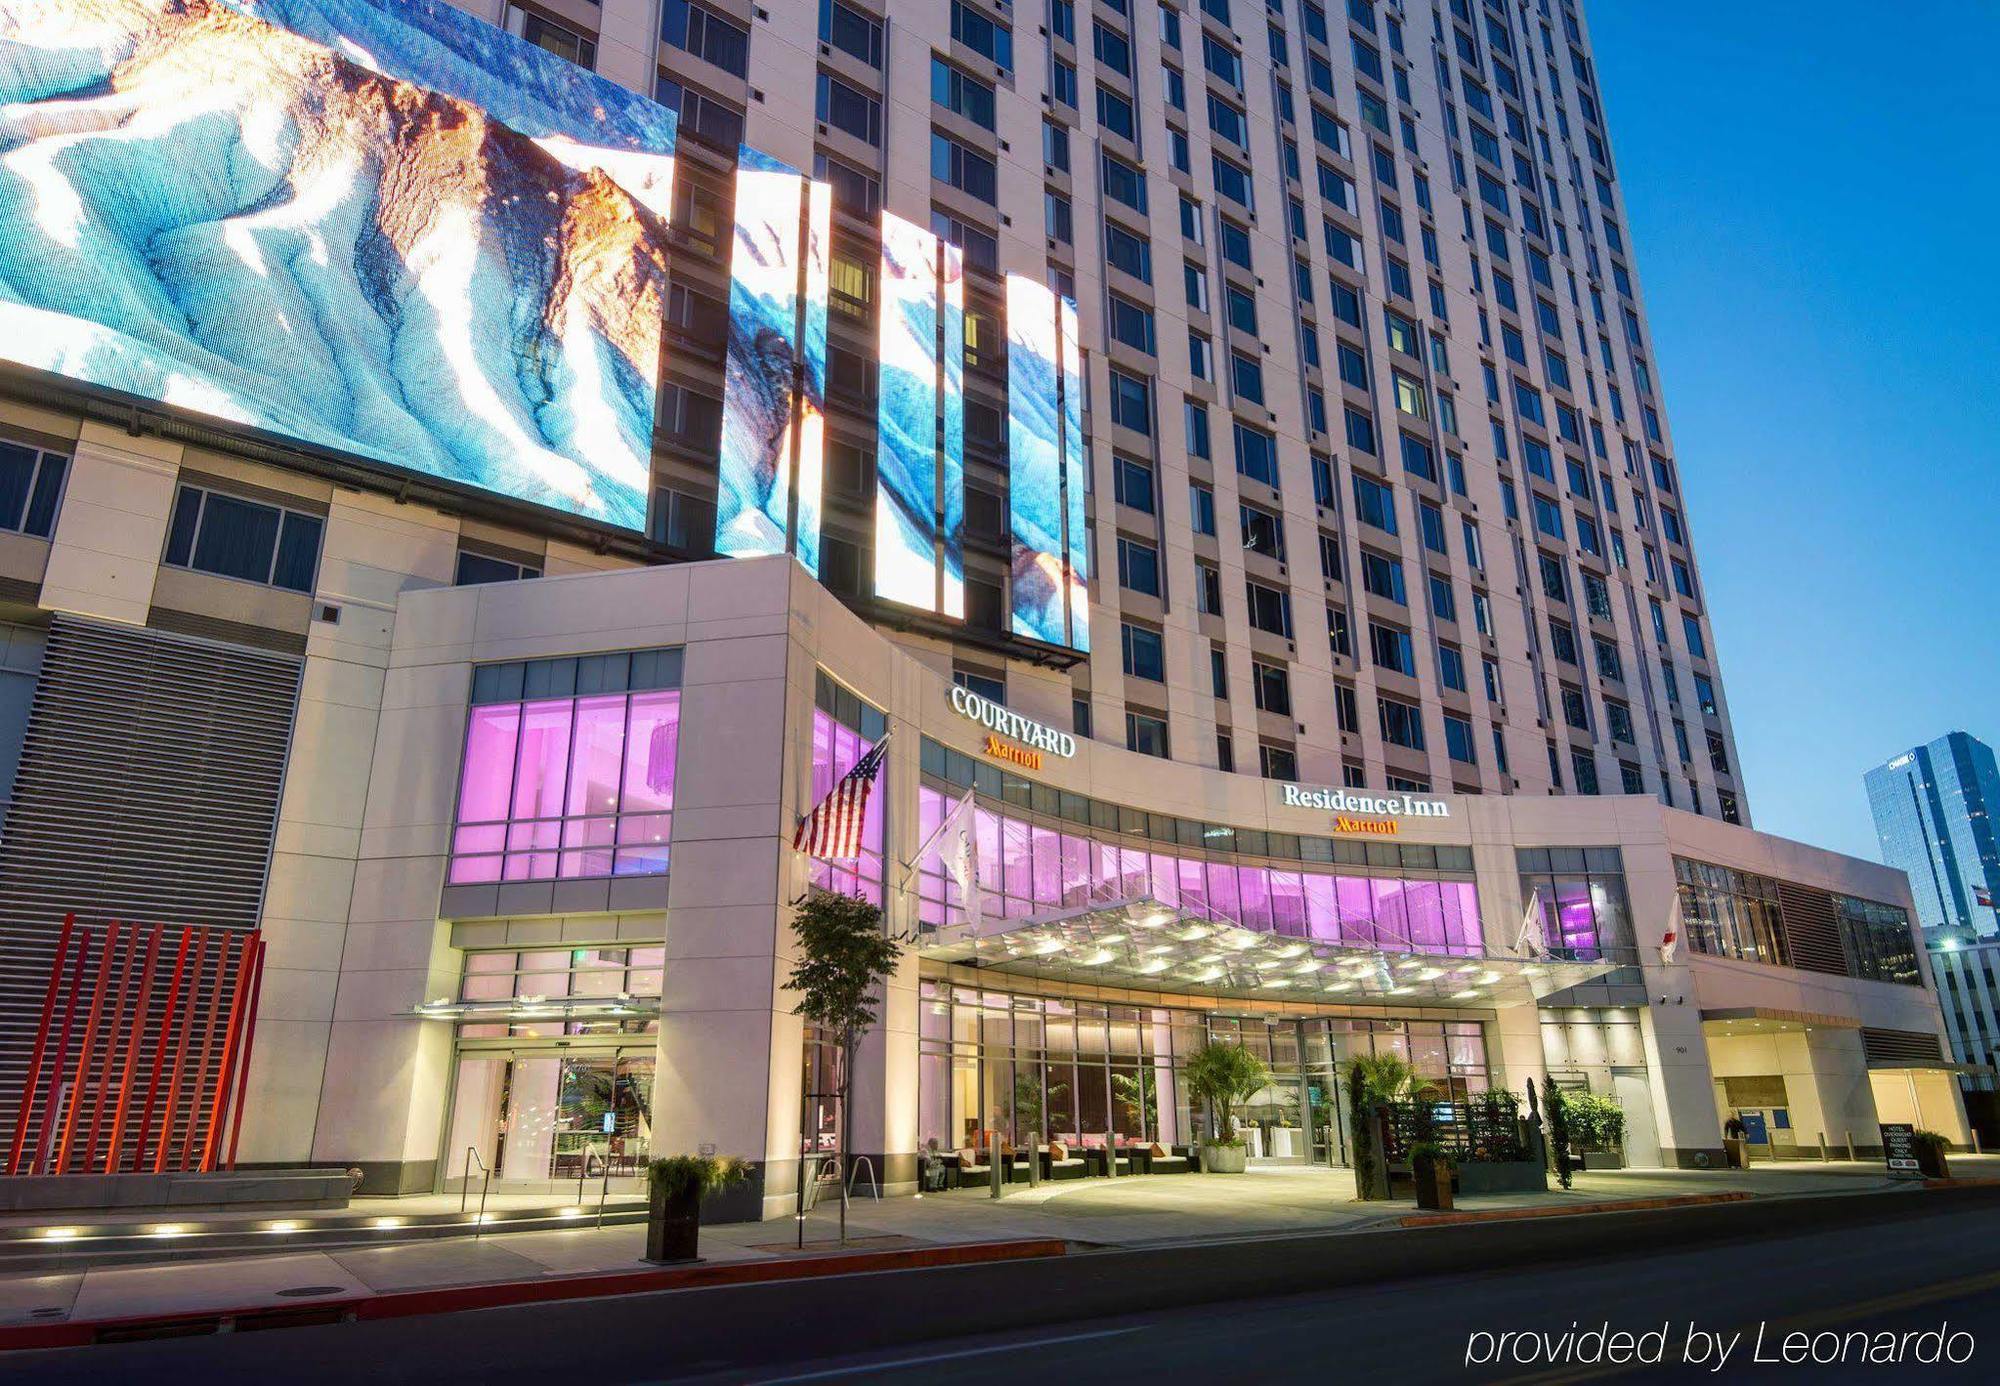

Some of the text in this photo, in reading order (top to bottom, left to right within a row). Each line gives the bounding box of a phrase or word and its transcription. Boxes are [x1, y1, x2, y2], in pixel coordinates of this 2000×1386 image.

[951, 686, 1076, 759] COURTYARD
[985, 734, 1042, 770] Marriott
[1283, 784, 1450, 817] Residence Inn
[1335, 816, 1398, 835] Marriott
